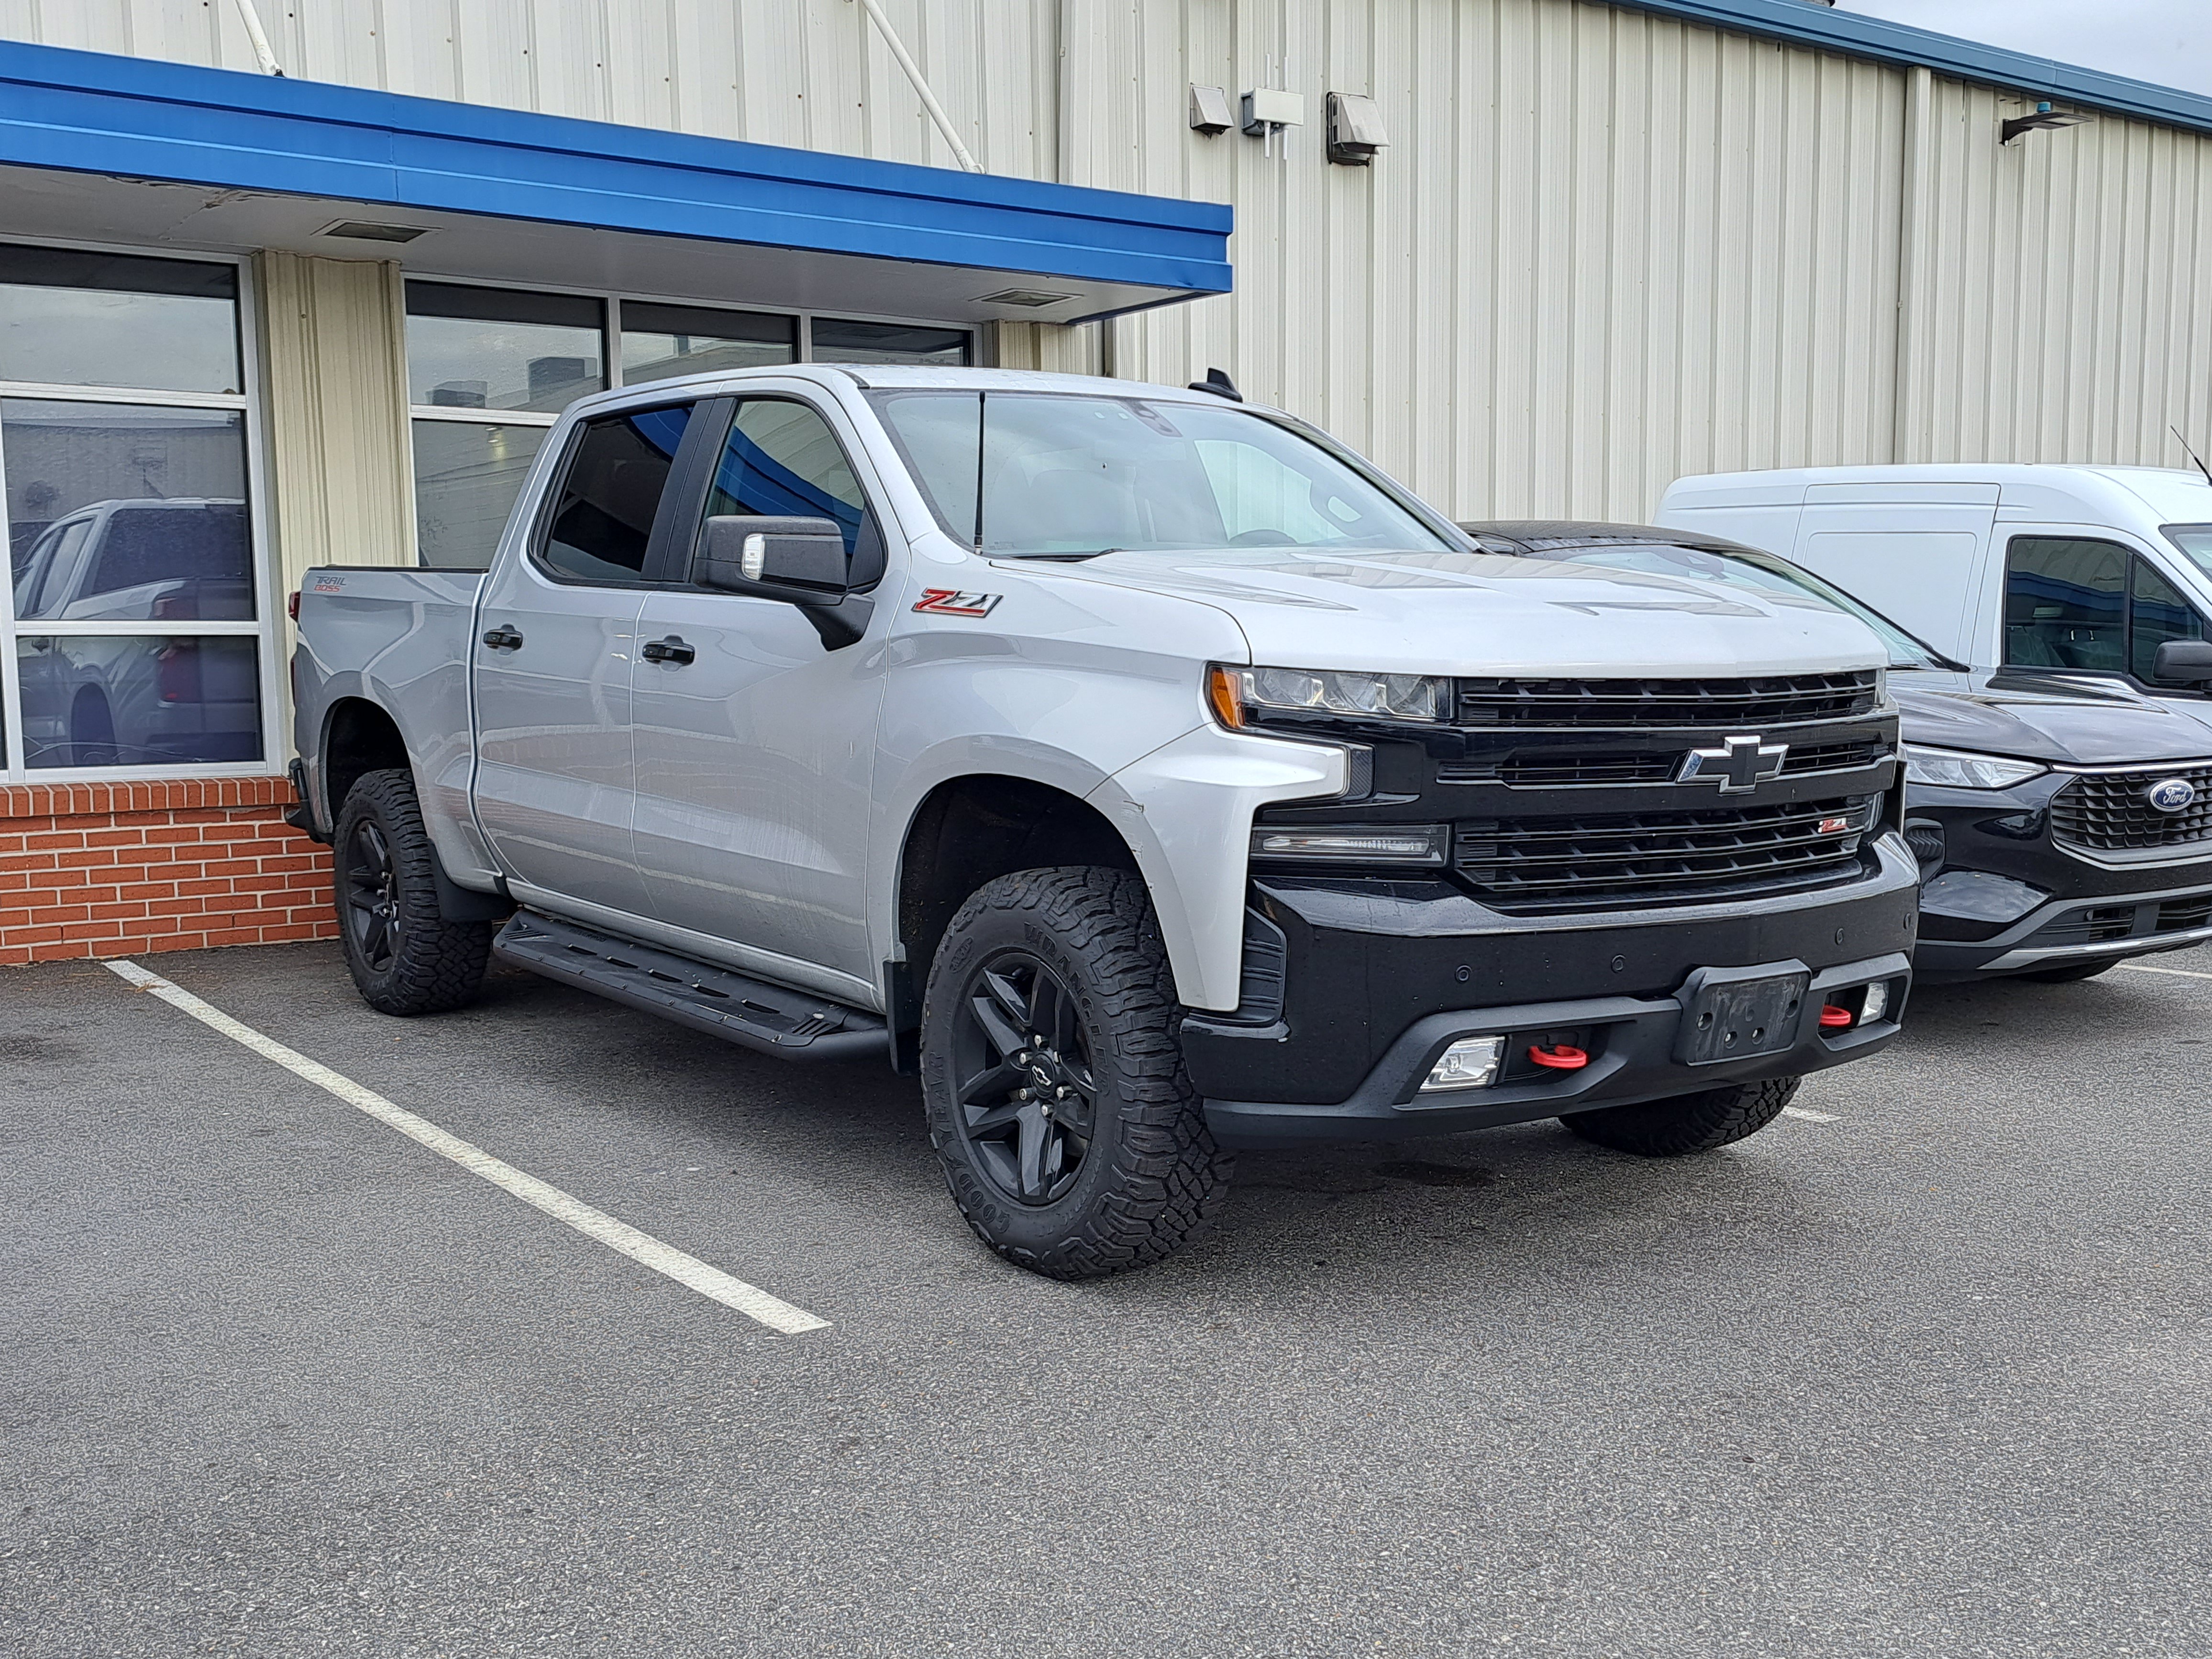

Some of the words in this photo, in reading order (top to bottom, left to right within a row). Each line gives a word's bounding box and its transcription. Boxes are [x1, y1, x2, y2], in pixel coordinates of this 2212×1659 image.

[314, 584, 341, 592] BOSS
[316, 576, 347, 586] TRAIL
[911, 587, 1004, 618] Z71
[2163, 786, 2191, 804] Ford
[1818, 817, 1847, 833] Z71
